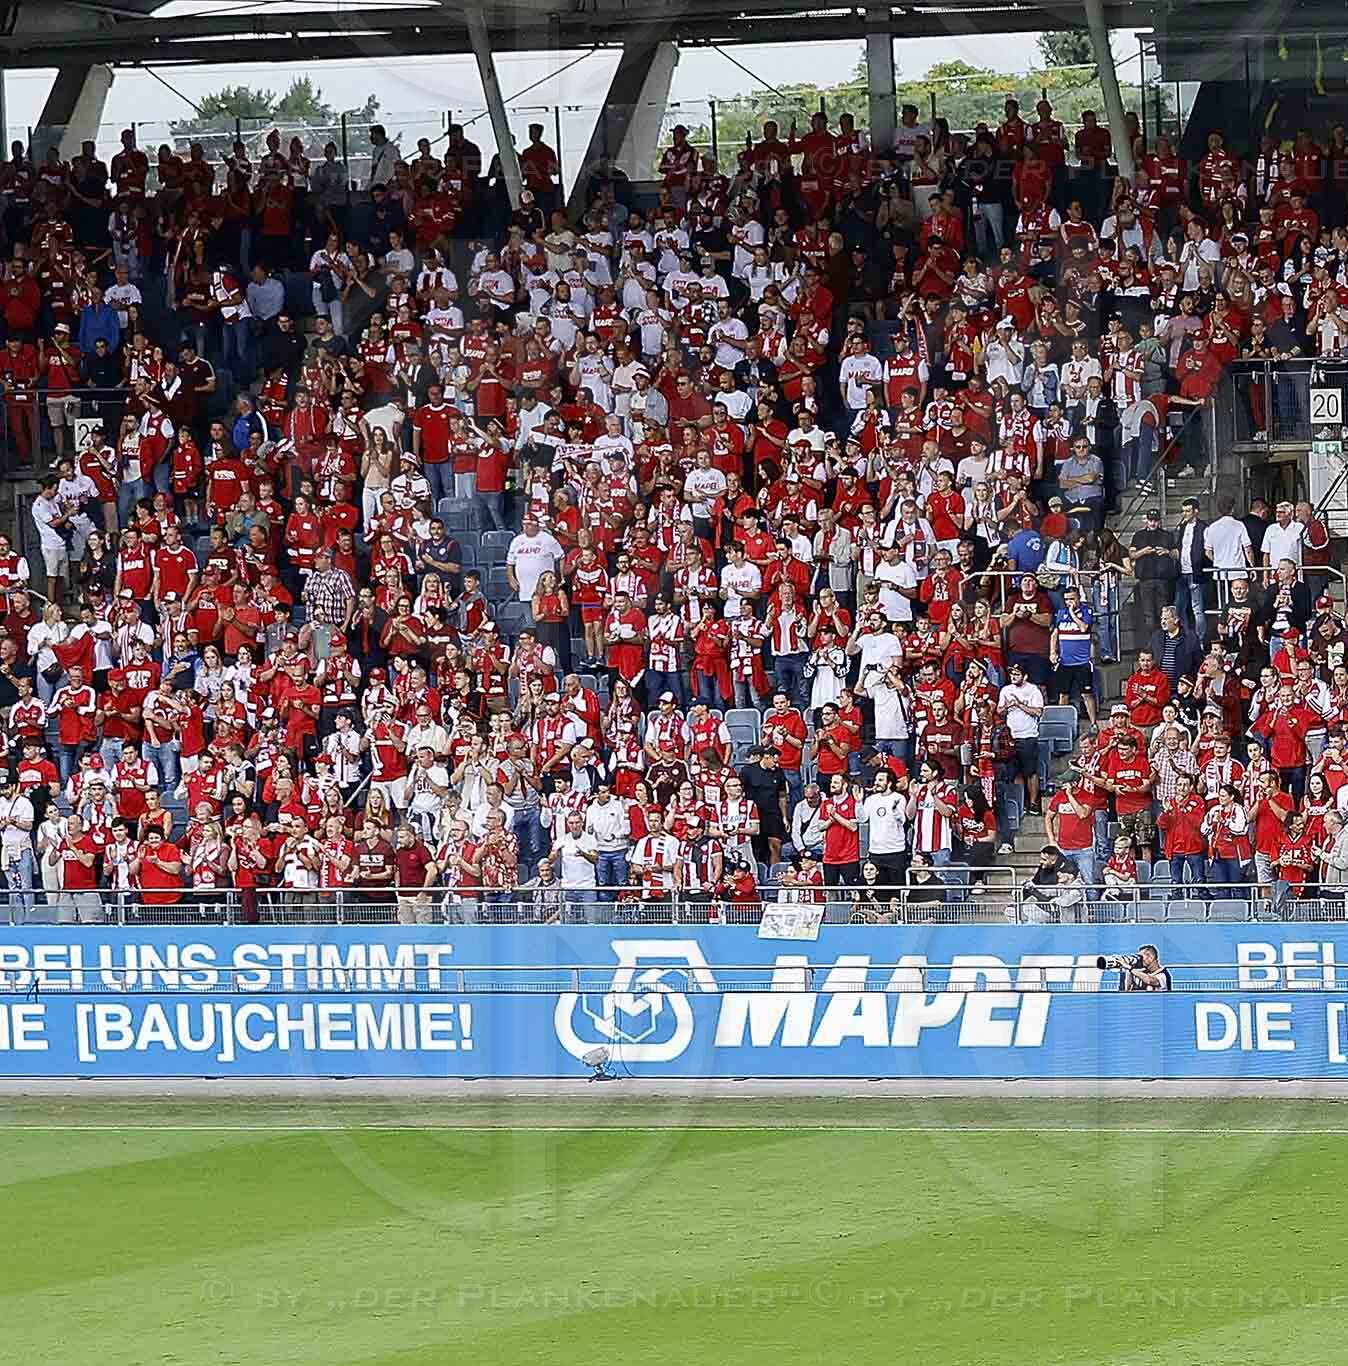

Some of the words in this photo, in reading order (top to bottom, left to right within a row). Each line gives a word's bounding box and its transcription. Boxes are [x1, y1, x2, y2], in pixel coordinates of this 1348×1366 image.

[1313, 394, 1338, 417] 20
[0, 943, 82, 991] BEI
[100, 943, 217, 991] UNS
[232, 943, 452, 991] STIMMT
[1238, 942, 1334, 990] BEI
[714, 955, 1103, 1047] MAPEI
[0, 1003, 48, 1050] IE
[77, 1003, 472, 1062] [BAU]CHEMIE!
[1196, 1003, 1295, 1051] DIE
